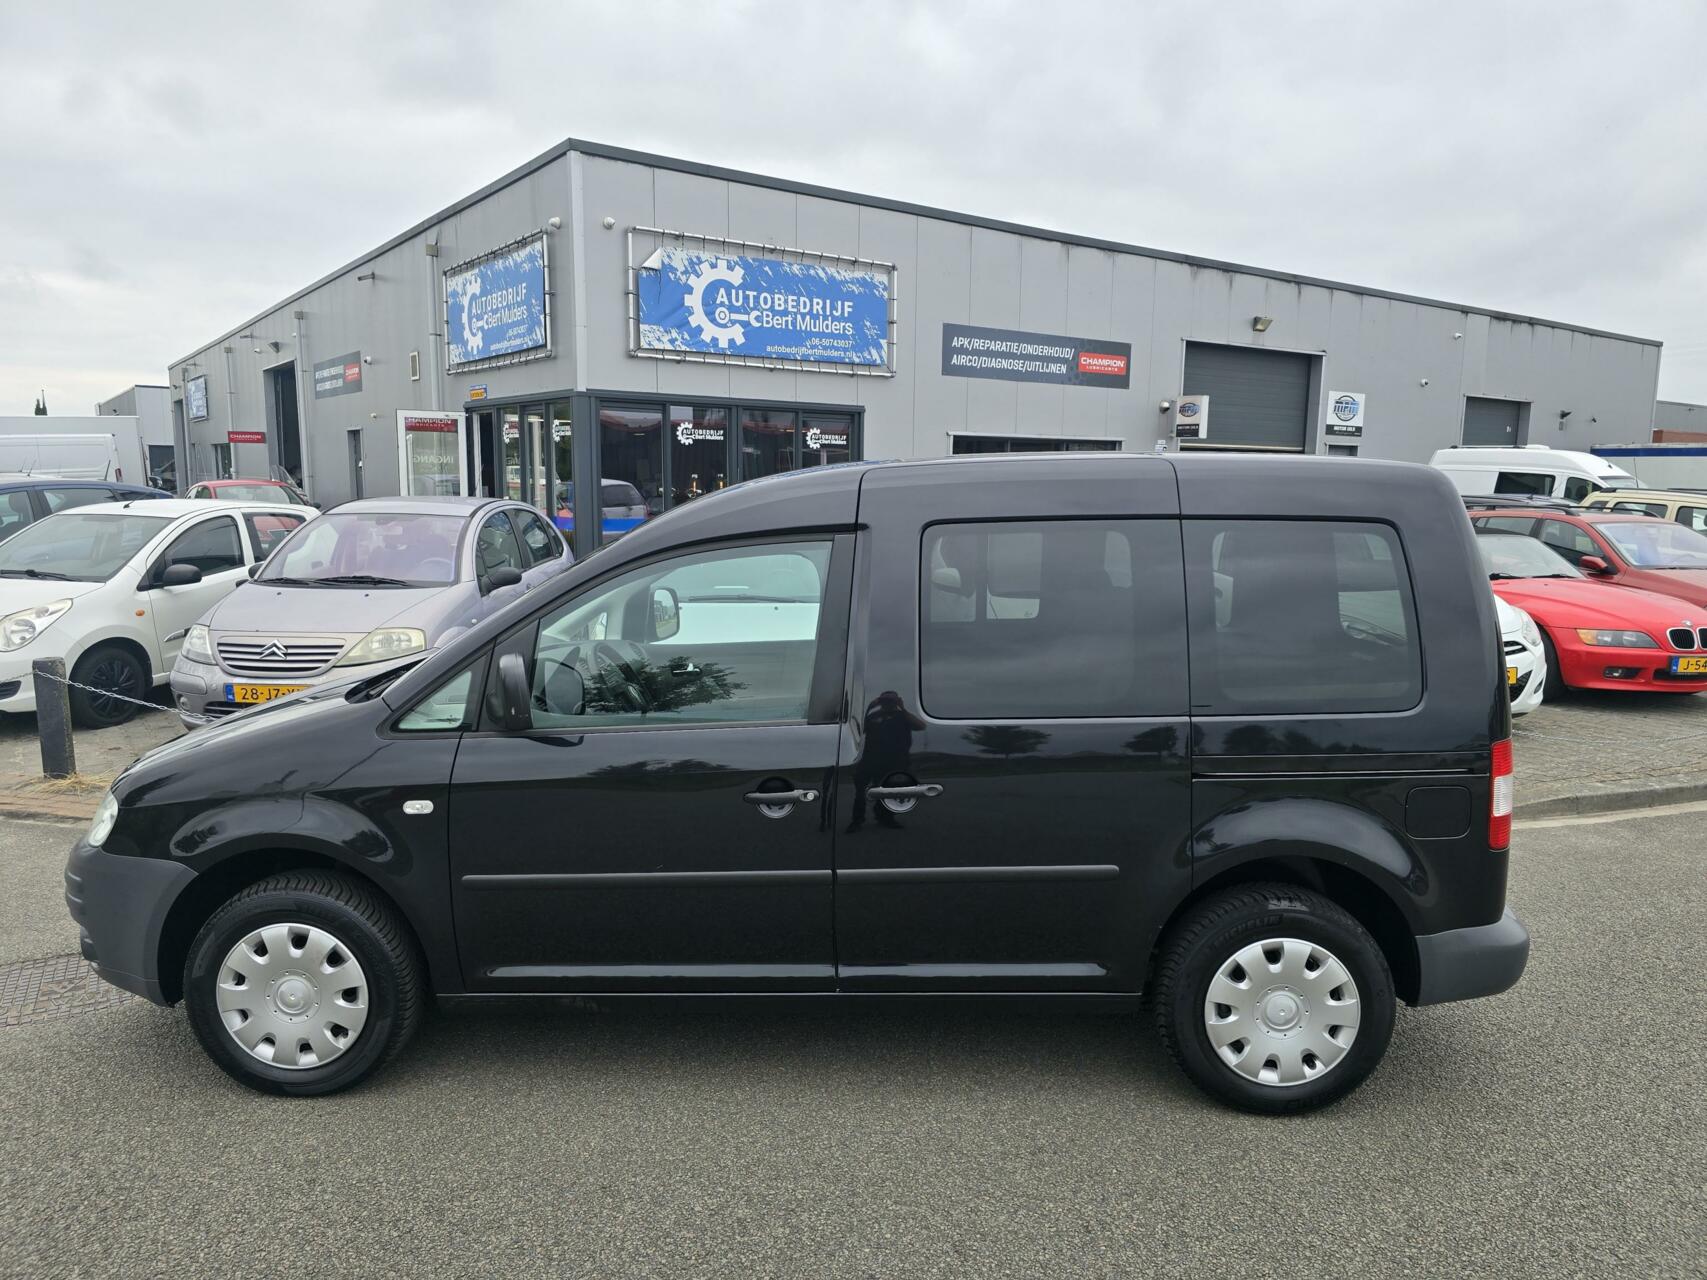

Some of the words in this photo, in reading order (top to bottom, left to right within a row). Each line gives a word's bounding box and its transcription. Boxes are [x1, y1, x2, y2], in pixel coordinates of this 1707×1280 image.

[472, 283, 527, 315] AUTOBEDRIJF
[716, 288, 853, 317] AUTOBEDRIJF
[488, 310, 502, 328] Bert
[502, 305, 527, 324] Mulders
[763, 311, 793, 329] Bert
[797, 314, 853, 335] Mulders
[766, 345, 854, 359] autobedrijfbertmulders.nl
[811, 337, 853, 348] 06-50743037
[952, 336, 1075, 361] APK/REPARATIE/ONDERHOUD/
[951, 354, 1067, 374] AIRCO/DIAGNOSE/UITLIJNEN
[1081, 357, 1124, 368] CHAMPION
